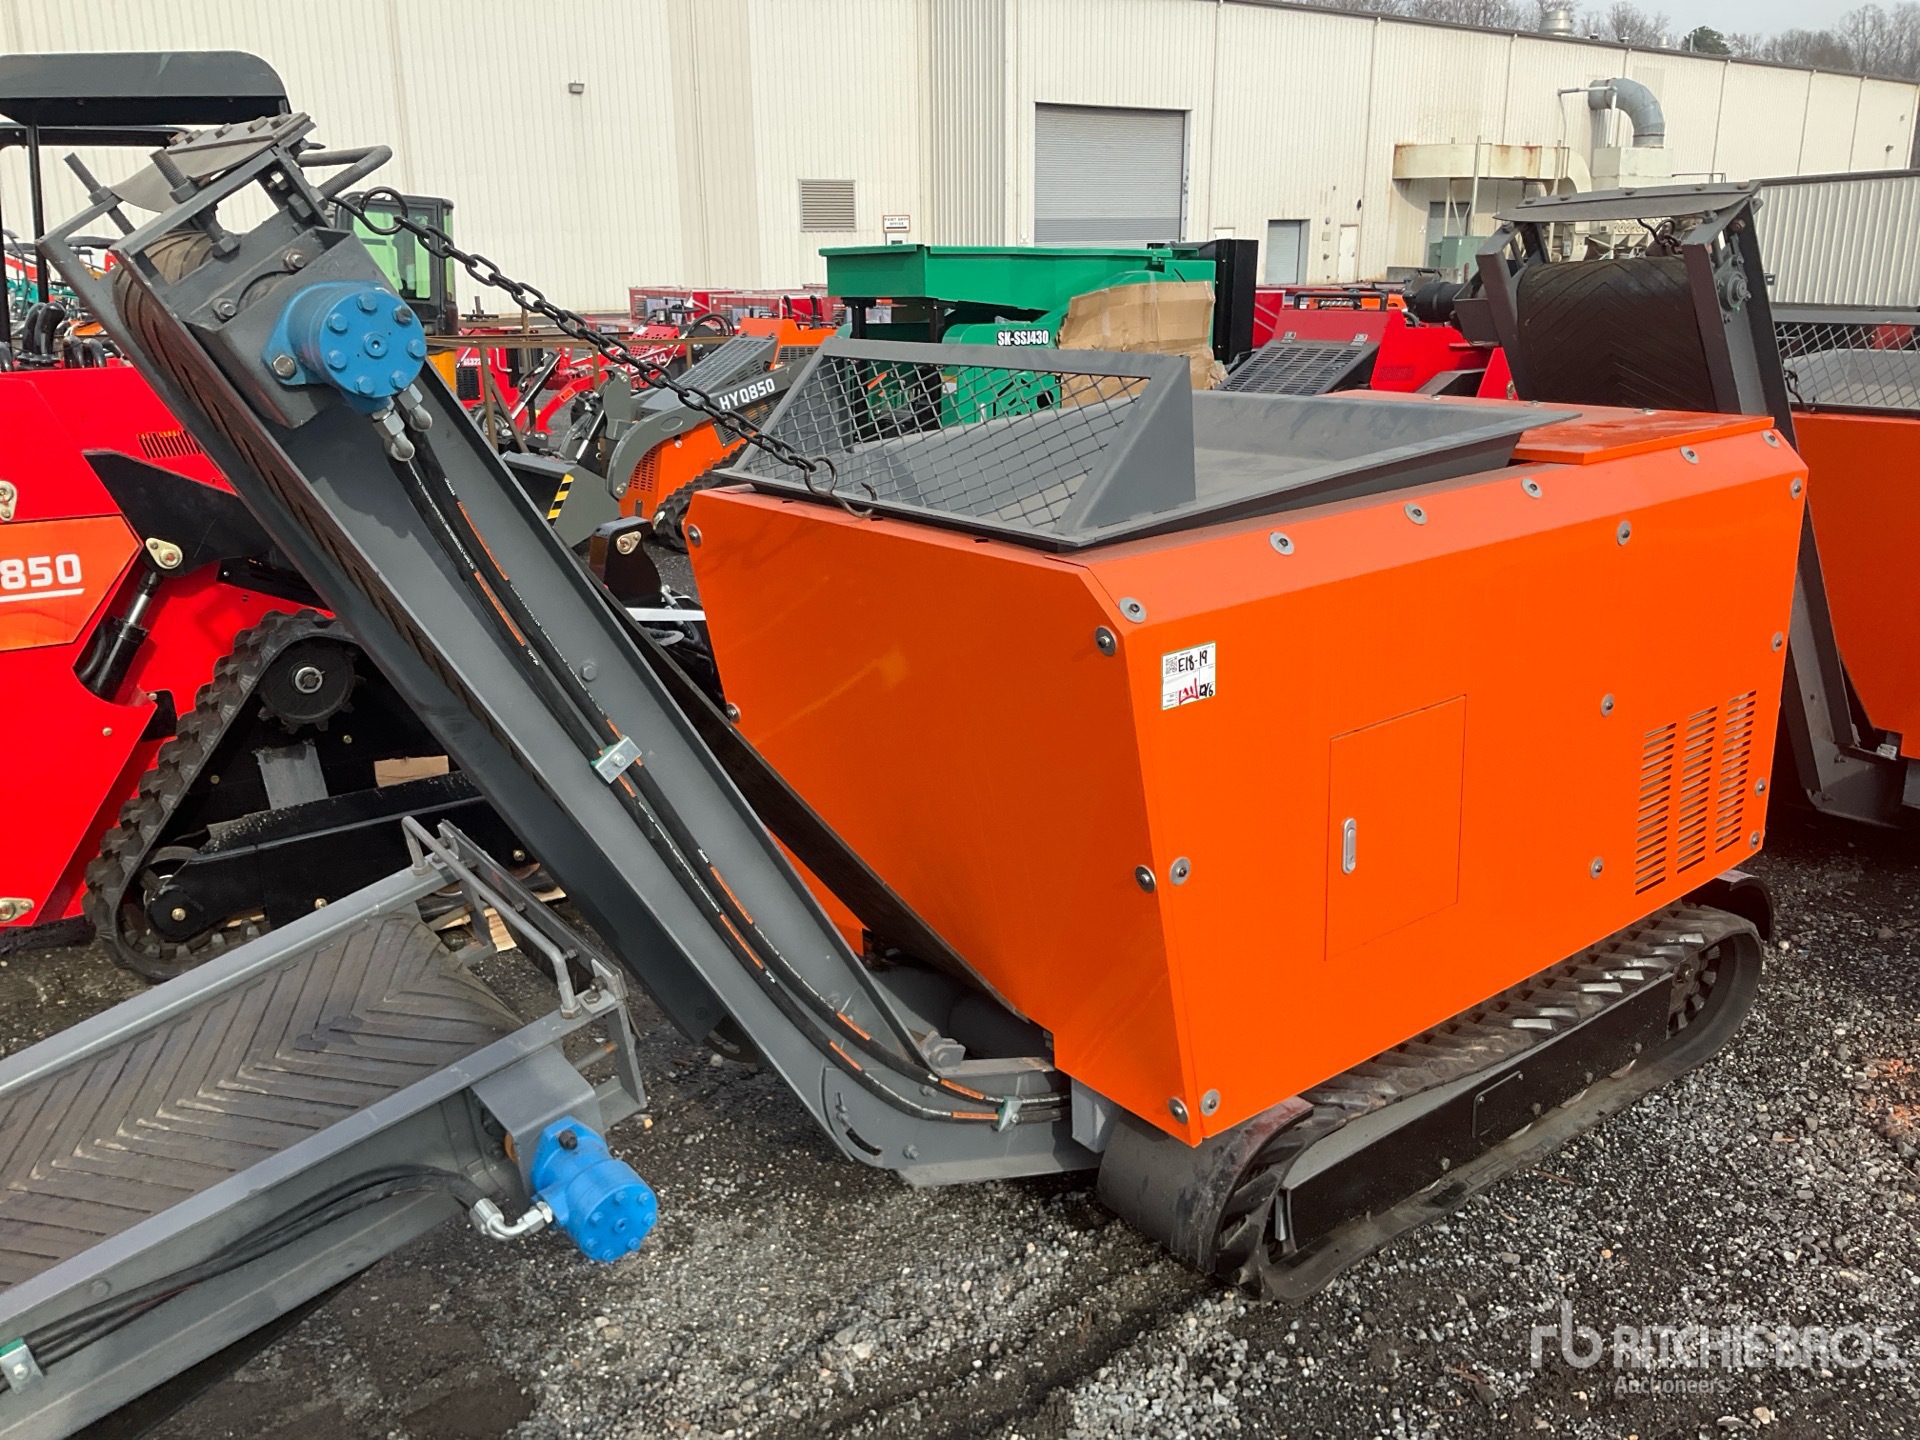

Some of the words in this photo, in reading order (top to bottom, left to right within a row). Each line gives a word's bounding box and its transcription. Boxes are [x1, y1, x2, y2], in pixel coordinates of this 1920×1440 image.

[997, 329, 1049, 346] SK-SSJ430
[719, 378, 775, 410] HYQ850
[0, 553, 82, 590] 850
[1178, 650, 1207, 672] E18-19
